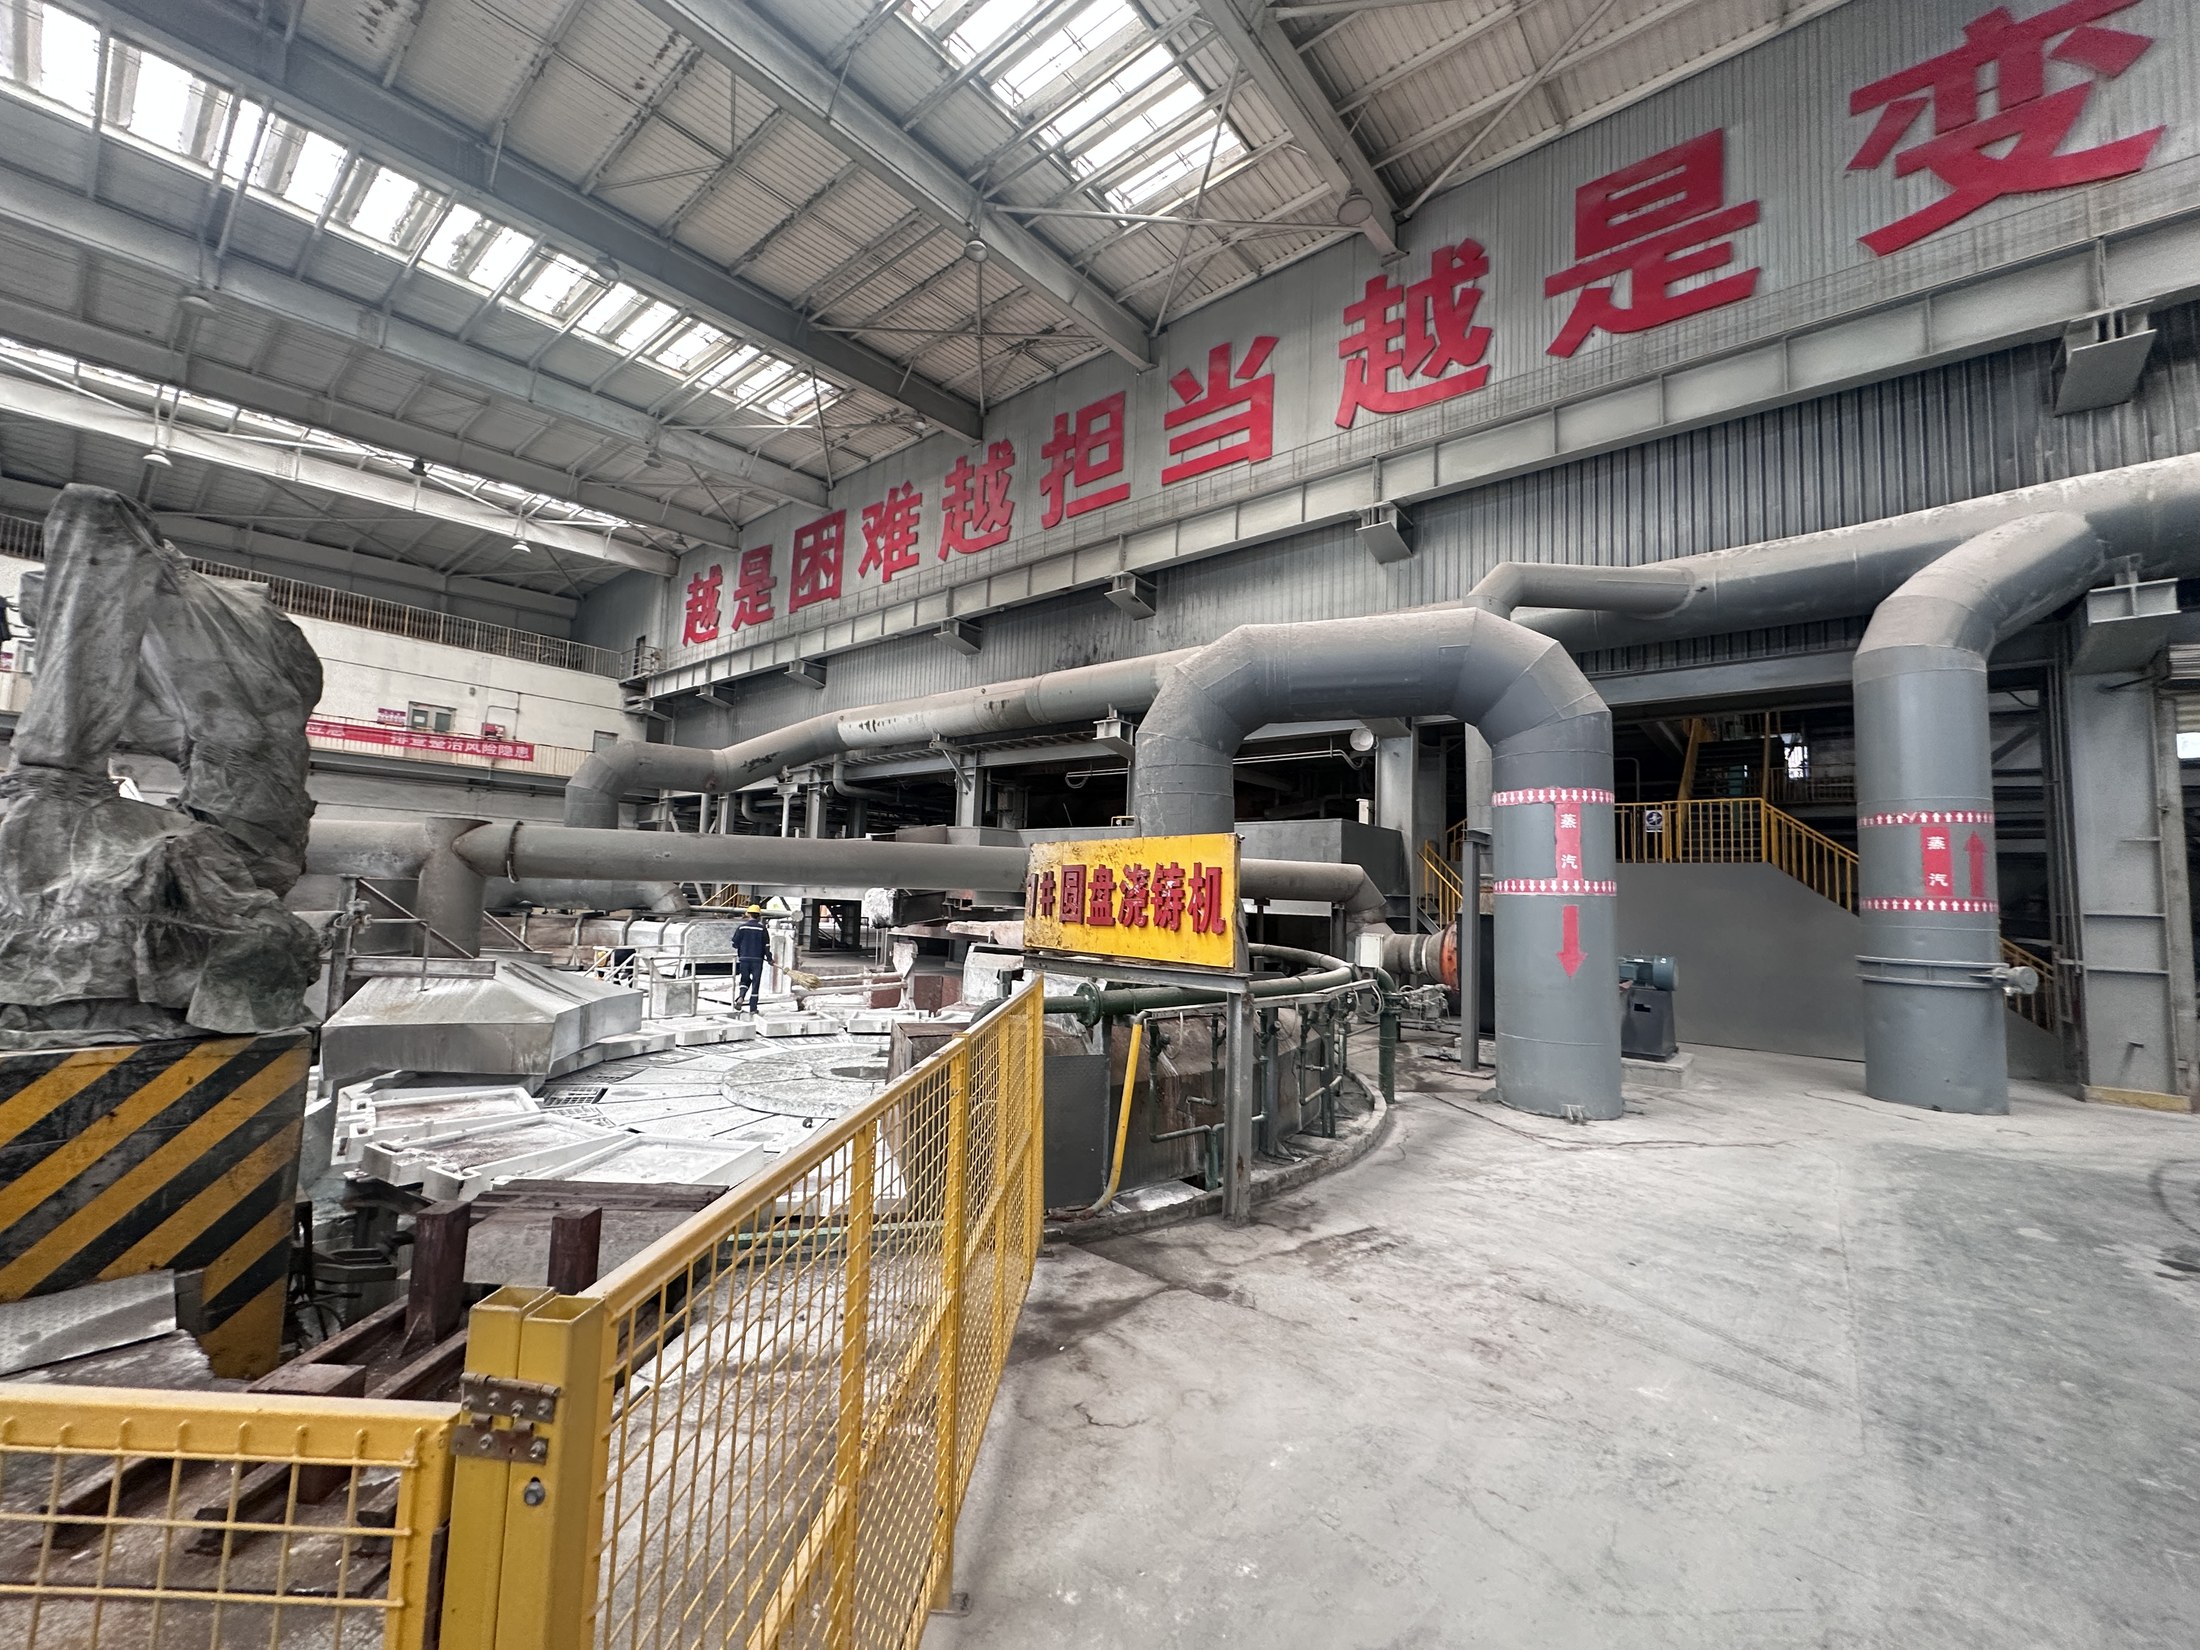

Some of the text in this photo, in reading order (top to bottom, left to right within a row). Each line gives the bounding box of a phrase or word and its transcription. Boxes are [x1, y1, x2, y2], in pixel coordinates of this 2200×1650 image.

[1560, 813, 1578, 869] 蒸汽
[1926, 836, 1949, 887] 蒸汽
[1028, 861, 1227, 935] 1#圆盘浇铸机
